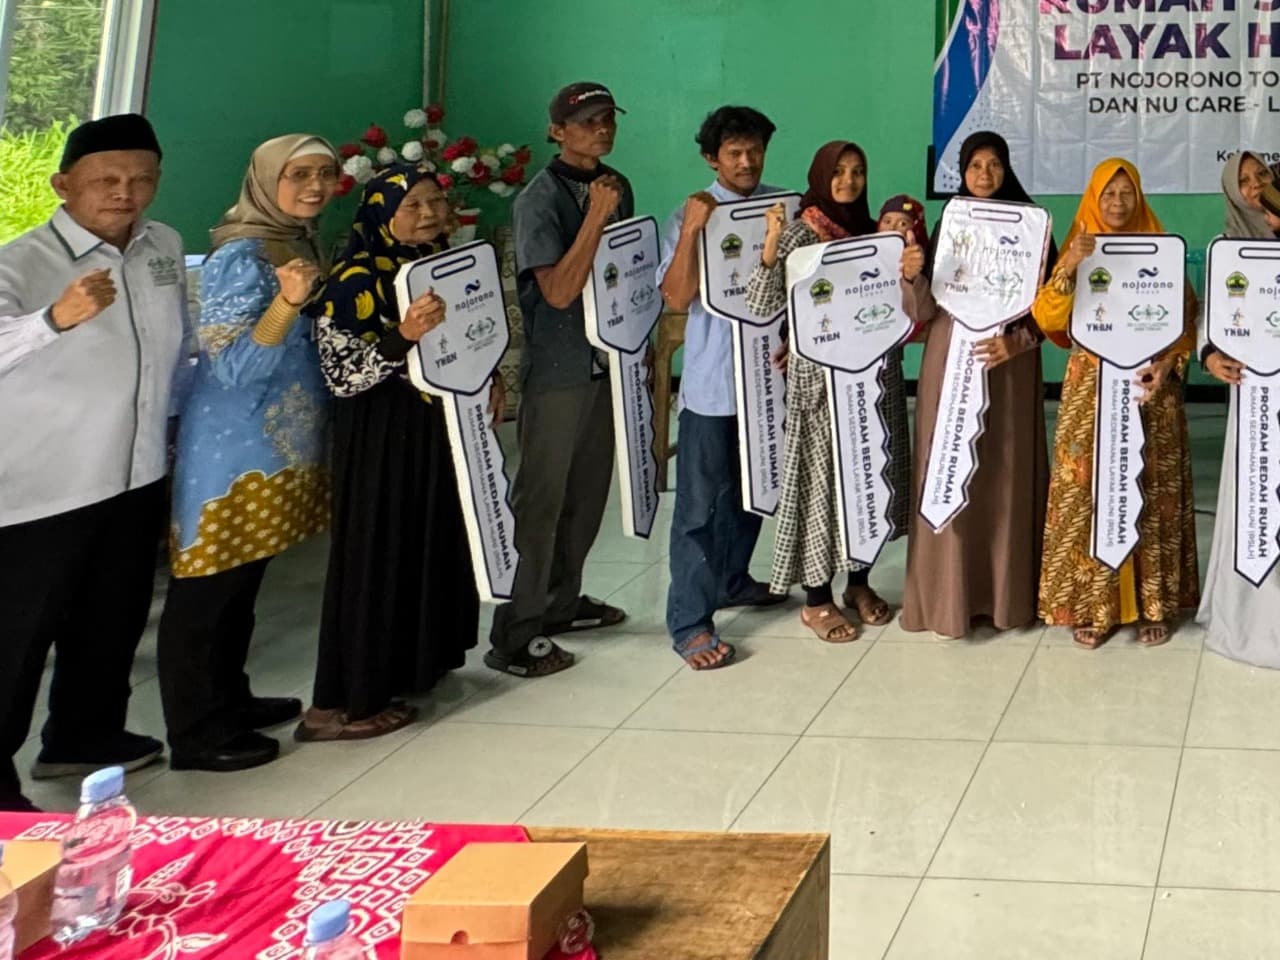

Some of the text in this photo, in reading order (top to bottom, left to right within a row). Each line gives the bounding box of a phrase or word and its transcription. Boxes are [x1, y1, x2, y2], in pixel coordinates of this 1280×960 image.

[1054, 22, 1232, 60] LAYAK
[1076, 72, 1103, 88] PT
[1110, 71, 1242, 88] NOJORONO
[1089, 96, 1138, 113] DAN
[1146, 96, 1178, 113] NU
[1185, 95, 1246, 113] CARE
[845, 279, 897, 295] nojorono
[1121, 280, 1174, 290] nojorono
[761, 335, 779, 489] PROGRAM BEDAH RUMAH
[952, 407, 966, 452] BEDAH
[856, 382, 878, 539] PROGRAM BEDAH RUMAH
[942, 455, 958, 504] RUMAH
[1118, 379, 1129, 544] PROGRAM BEDAH RUMAH
[1258, 386, 1269, 557] PROGRAM BEDAH RUMAH
[475, 404, 511, 571] PROGRAM BEDAH RUMAH
